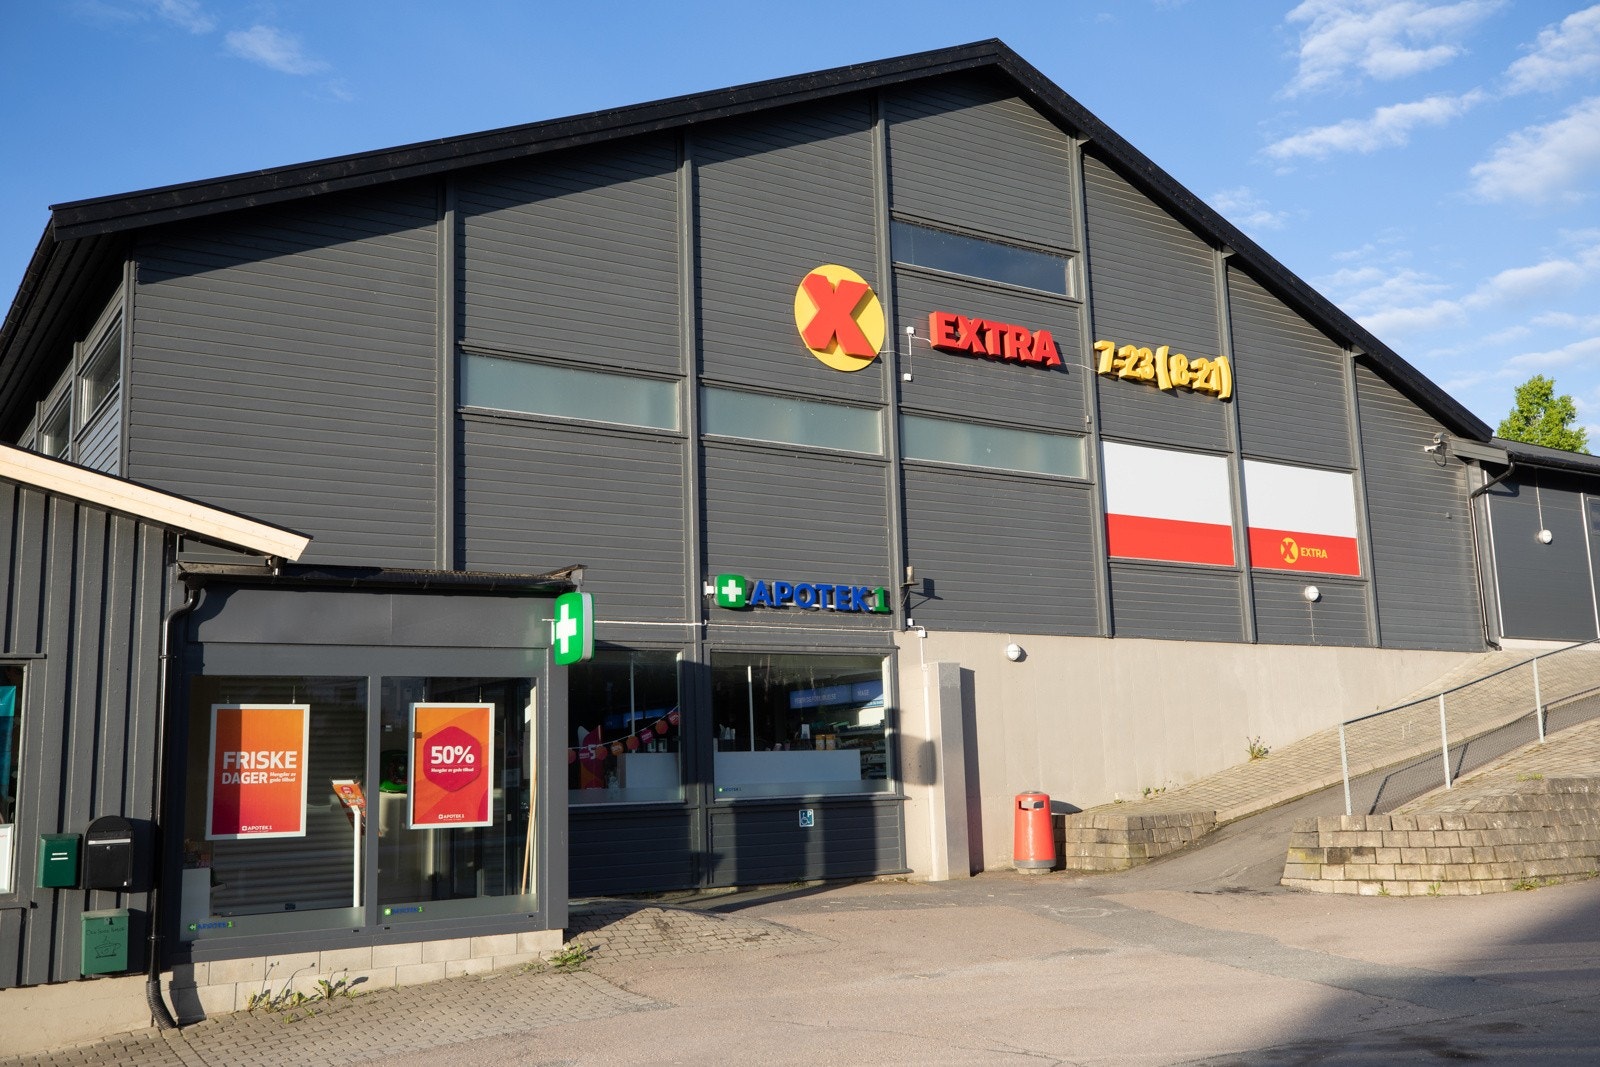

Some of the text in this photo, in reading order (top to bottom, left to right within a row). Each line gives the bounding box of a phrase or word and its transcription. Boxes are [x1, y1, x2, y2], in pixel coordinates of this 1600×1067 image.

[929, 311, 1061, 366] EXTRA
[1300, 547, 1328, 558] EXTRA
[751, 580, 870, 612] APOTEK
[223, 751, 298, 769] FRISKE
[430, 745, 475, 764] 50%
[222, 771, 268, 785] DAGER
